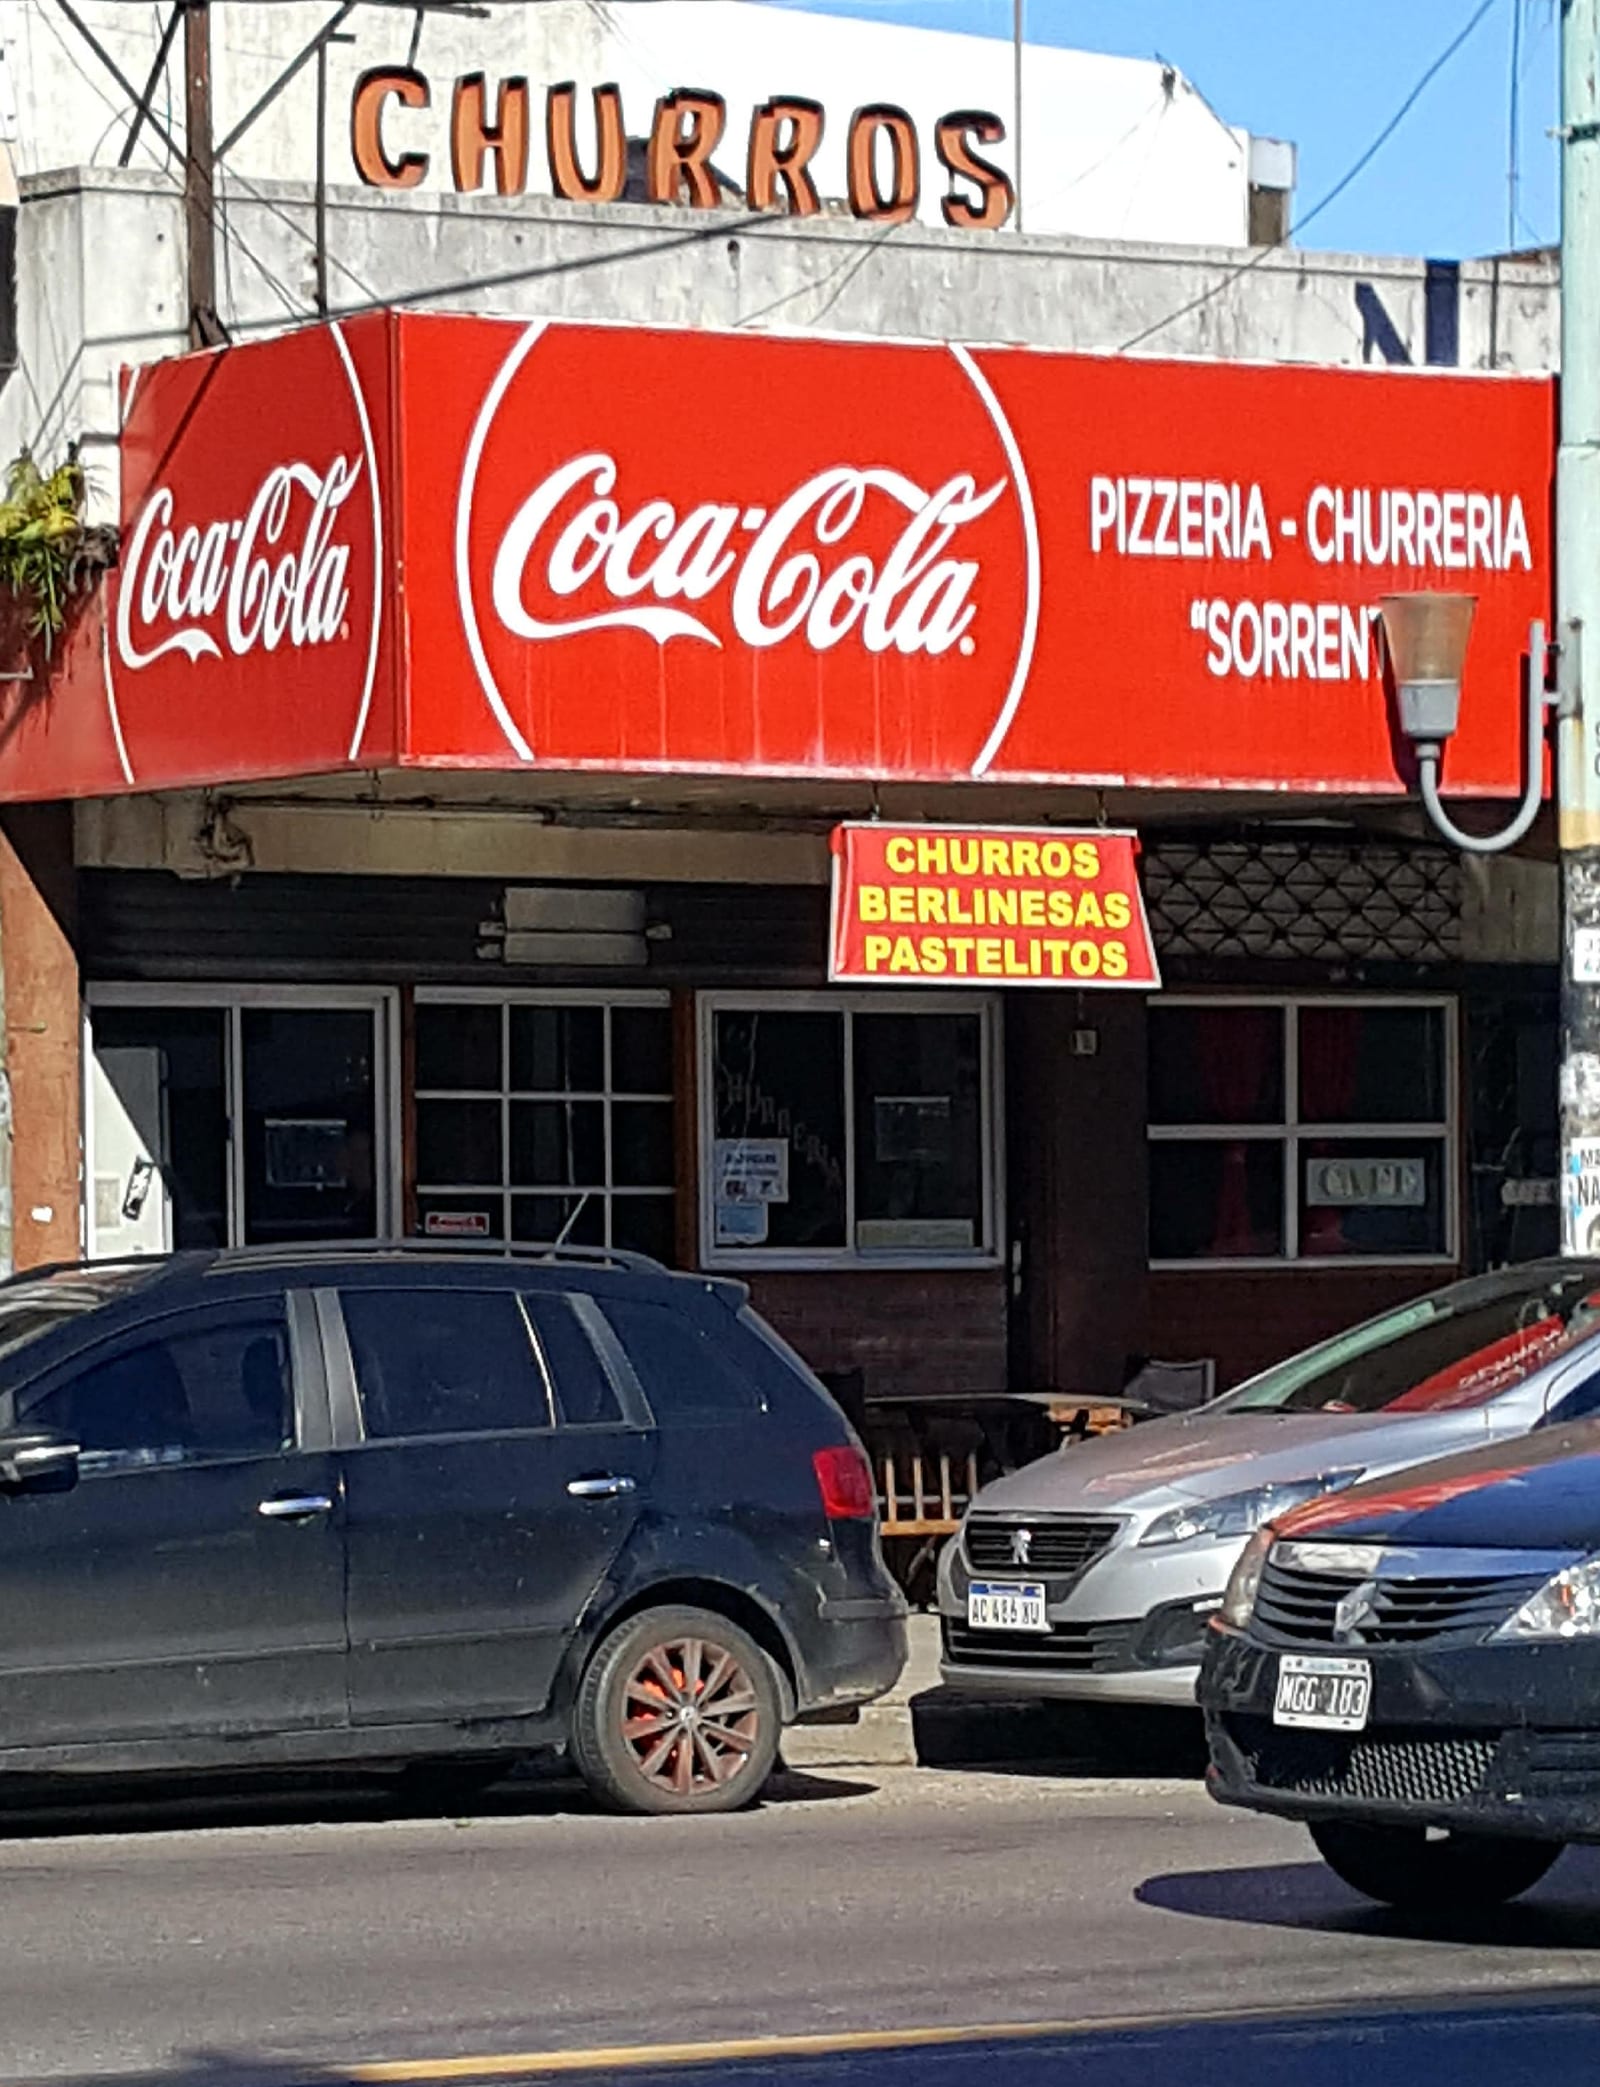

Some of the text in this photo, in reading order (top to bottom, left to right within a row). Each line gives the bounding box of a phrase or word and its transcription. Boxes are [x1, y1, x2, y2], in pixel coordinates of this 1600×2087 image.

[350, 65, 1014, 230] CHURROS
[117, 451, 363, 669] Coca-Cola
[493, 452, 1007, 655] Coca-Cola
[1090, 476, 1272, 560] PIZZERIA
[1306, 486, 1533, 571] CHURRERIA
[886, 836, 1100, 879] CHURROS
[858, 885, 1131, 929] BERLINESAS
[865, 935, 1129, 978] PASTELITOS
